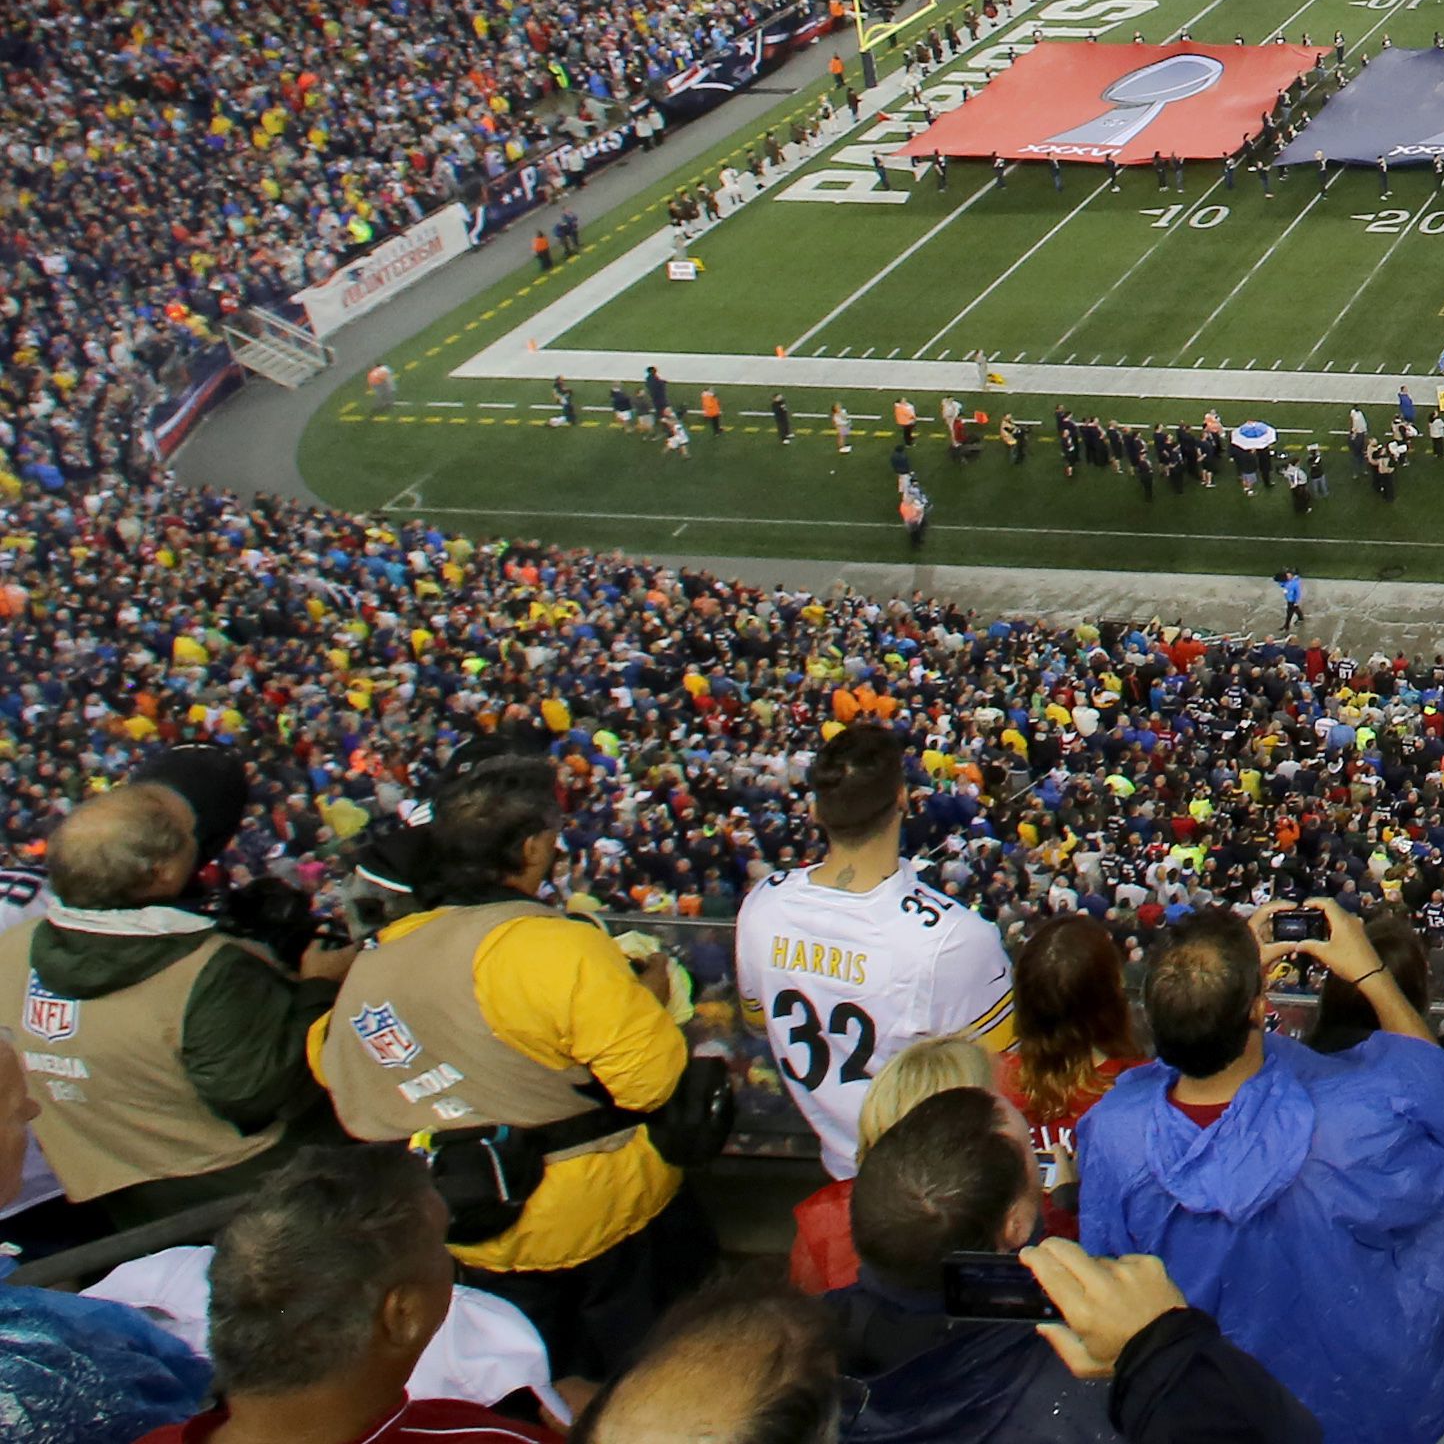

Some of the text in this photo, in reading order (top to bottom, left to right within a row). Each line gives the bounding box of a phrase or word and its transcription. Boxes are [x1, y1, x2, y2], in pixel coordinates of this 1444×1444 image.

[1150, 203, 1231, 230] 10
[771, 936, 867, 985] HARRIS
[30, 999, 72, 1031] NFL
[367, 1032, 412, 1063] NFL
[772, 989, 876, 1093] 32
[22, 1051, 91, 1078] MEDIA
